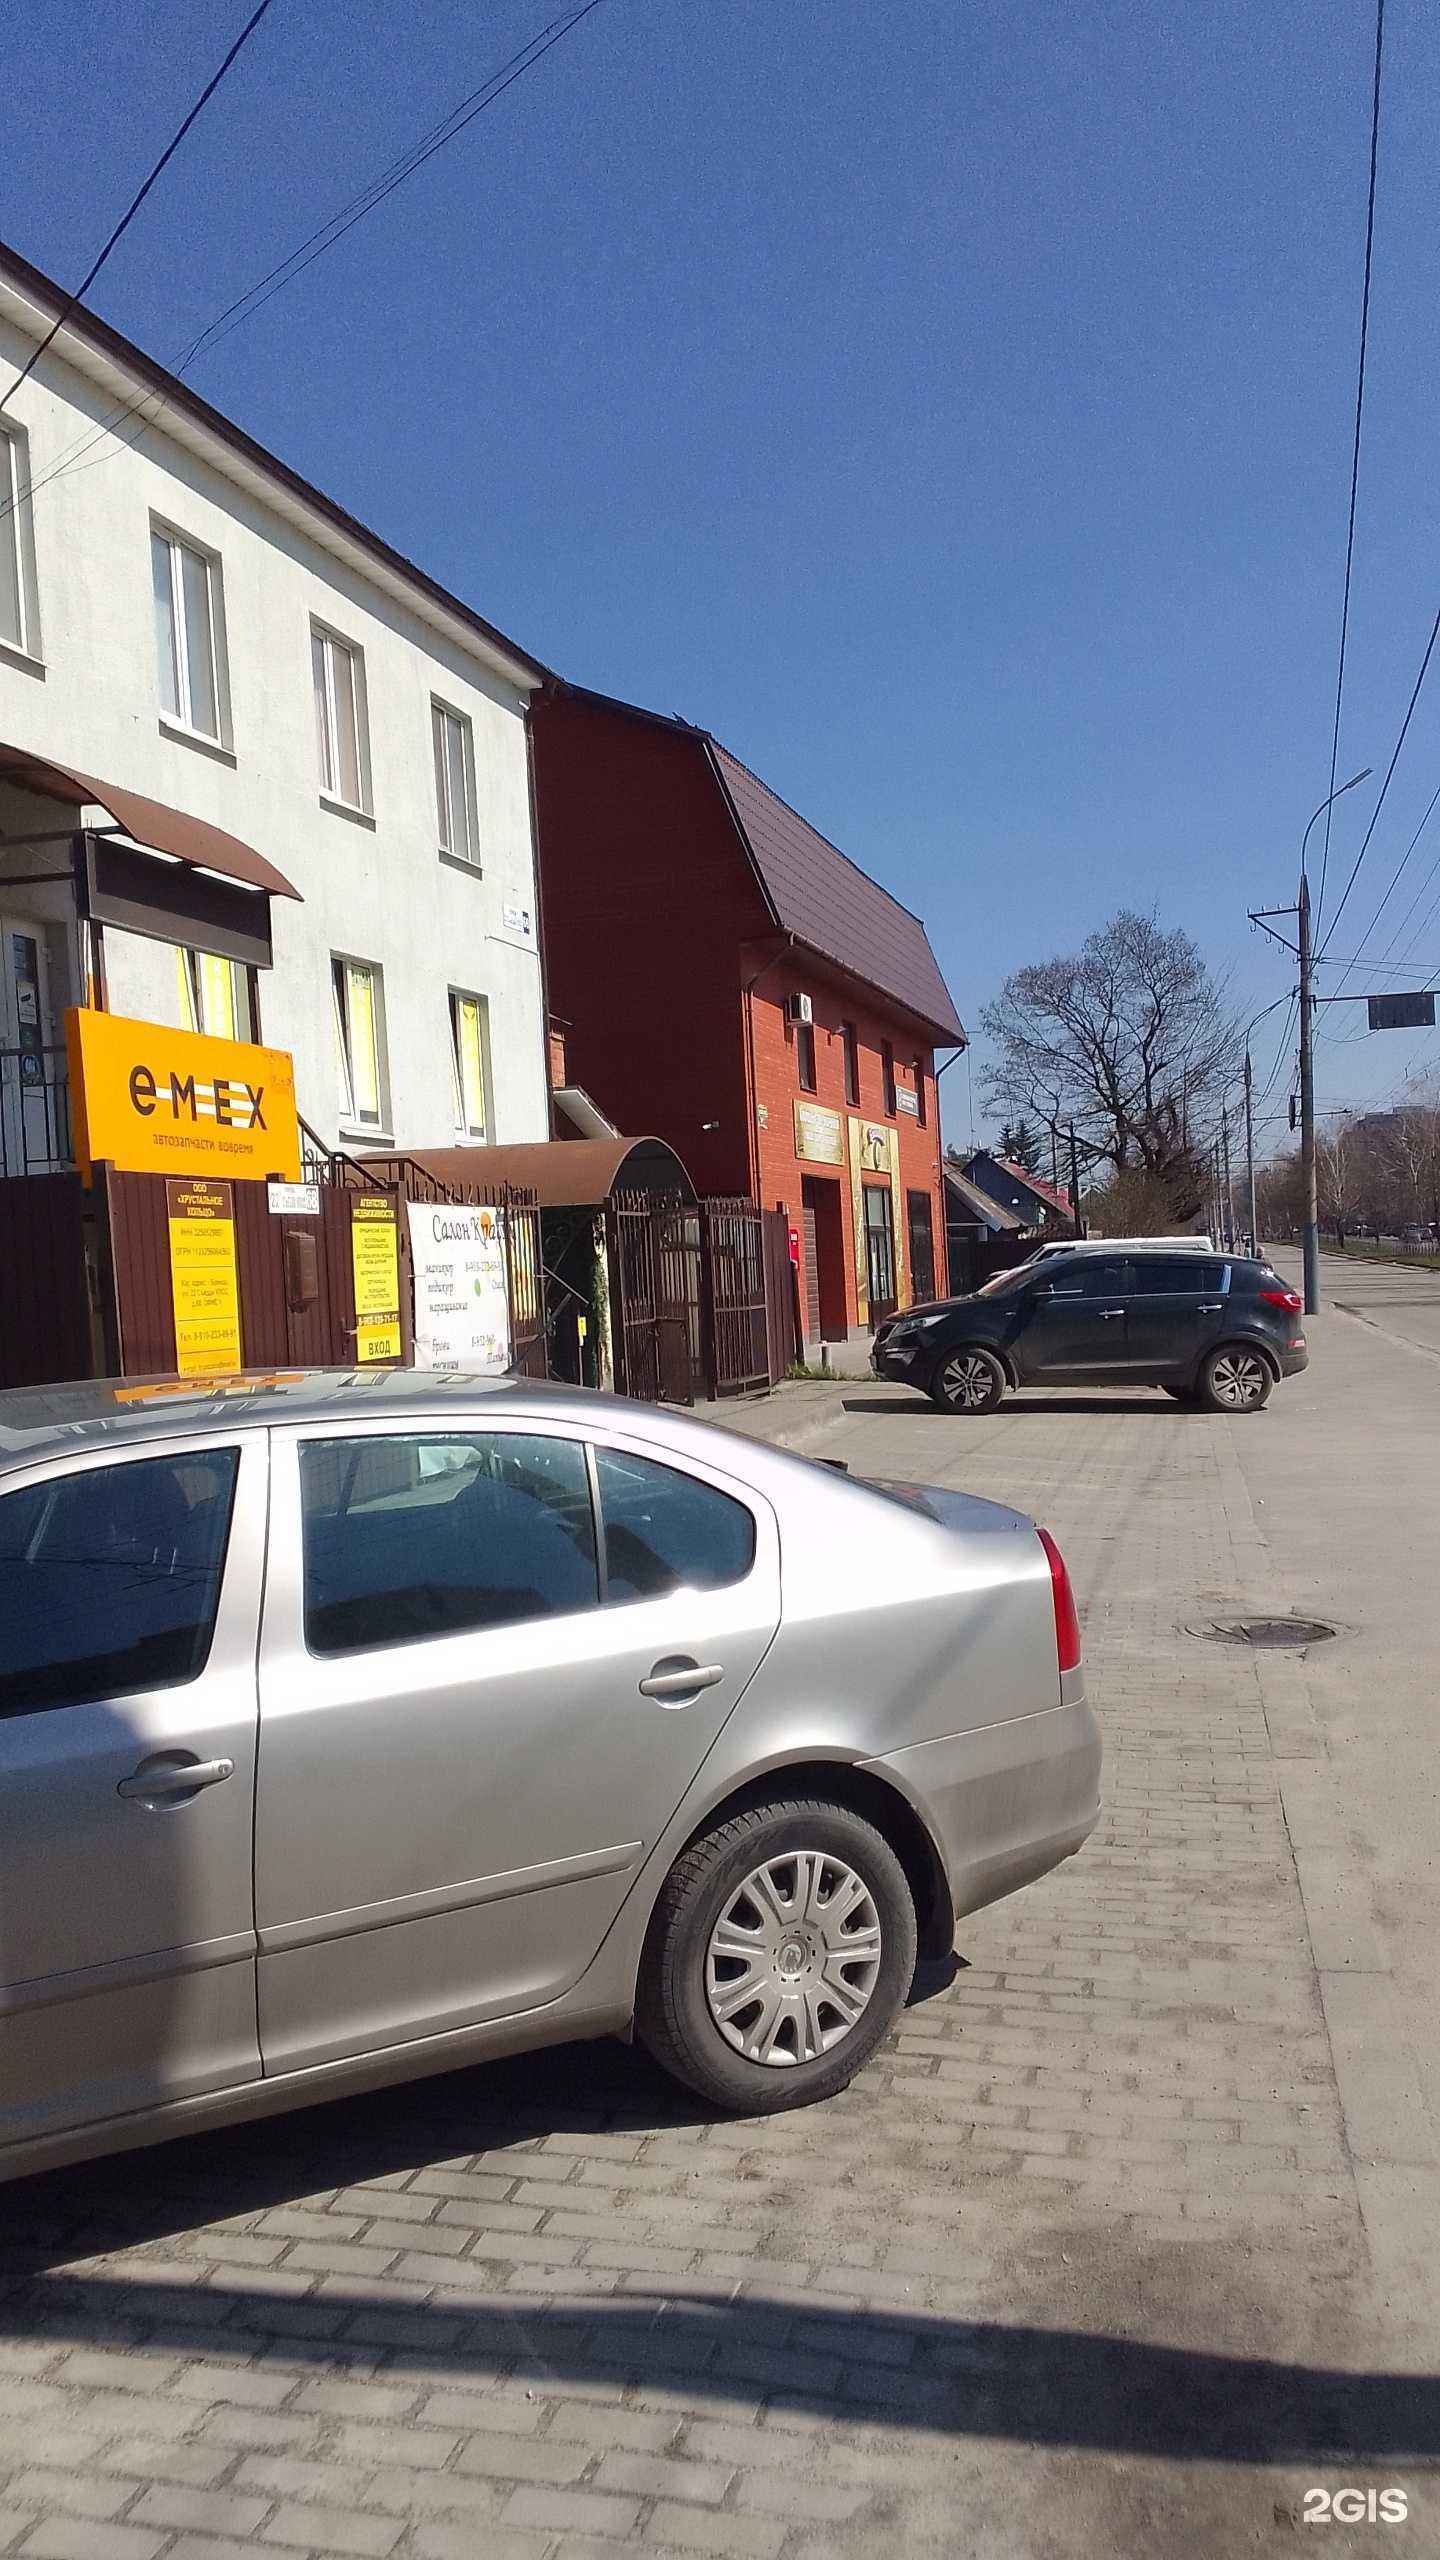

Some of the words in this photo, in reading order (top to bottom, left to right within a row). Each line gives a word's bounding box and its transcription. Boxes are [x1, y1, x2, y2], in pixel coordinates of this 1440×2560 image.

[152, 1133, 216, 1152] автозапчасти
[218, 1138, 254, 1158] вовремя
[192, 1183, 208, 1193] ООО
[433, 1214, 471, 1243] Салон
[368, 1340, 391, 1356] ВХОД
